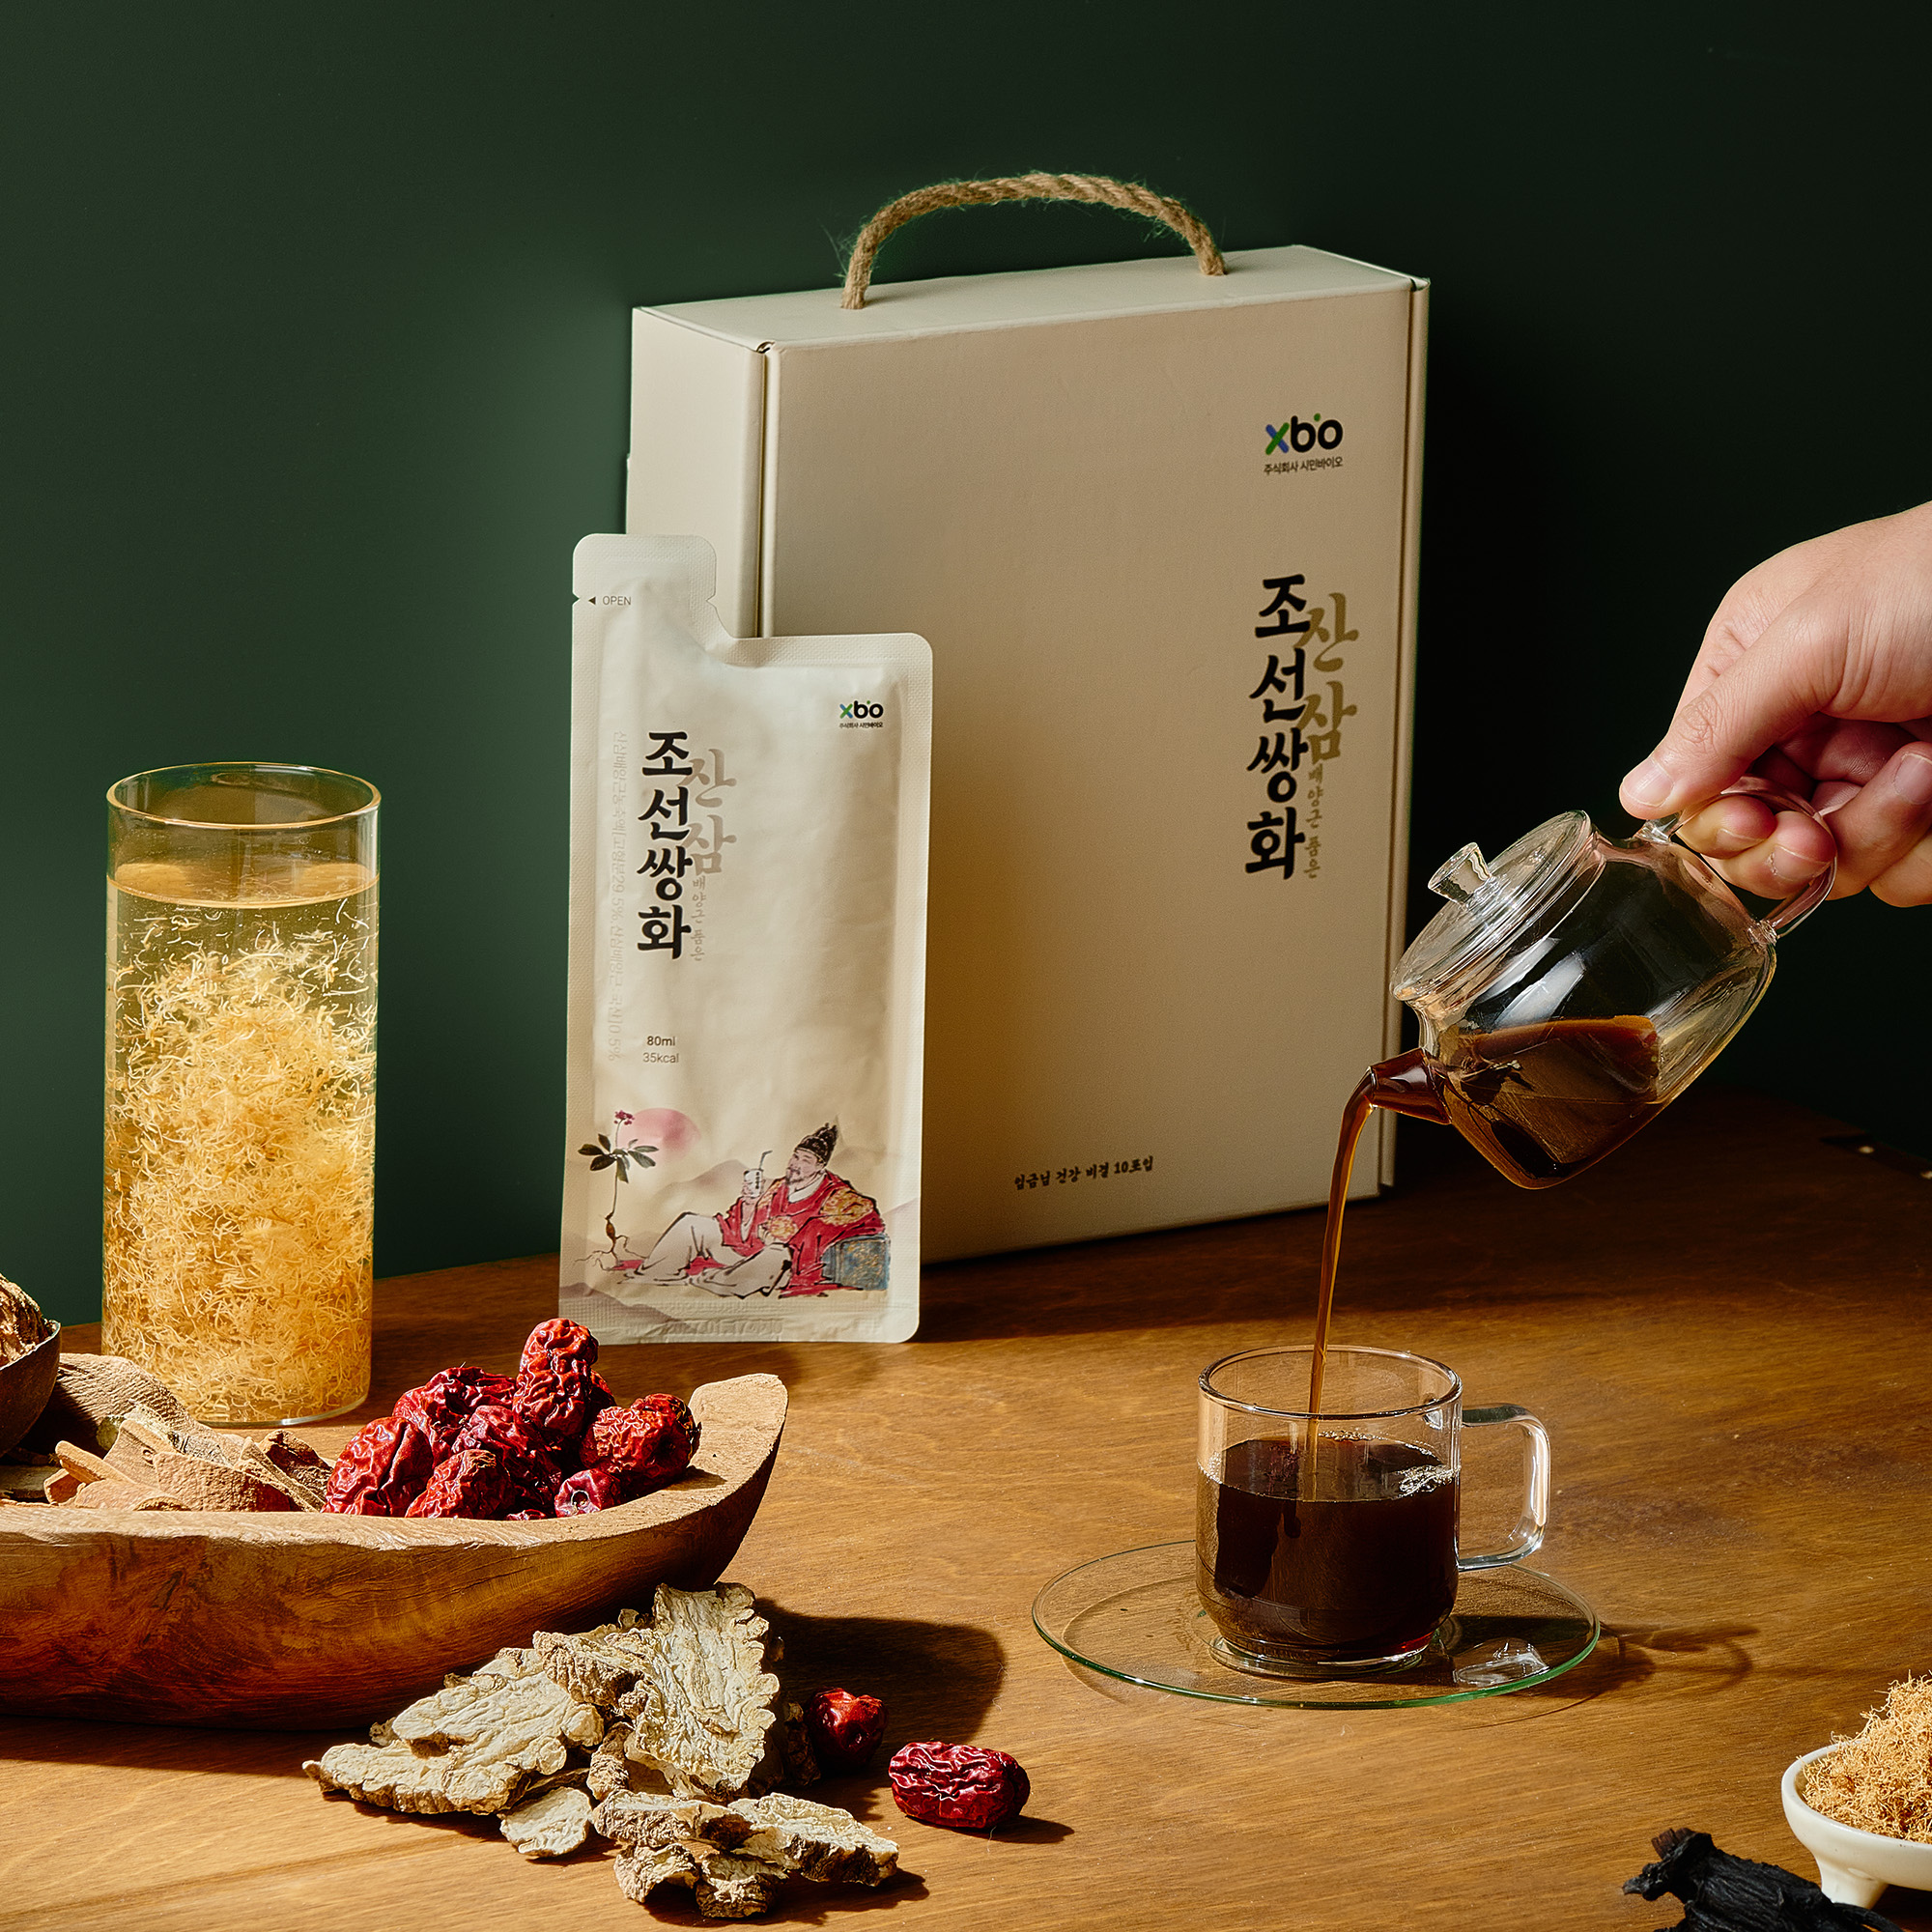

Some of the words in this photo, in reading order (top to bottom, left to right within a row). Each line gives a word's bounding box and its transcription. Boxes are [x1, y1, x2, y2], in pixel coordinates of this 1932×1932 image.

[1264, 461, 1298, 475] 주식회사
[602, 595, 632, 606] OPEN
[1245, 574, 1311, 880] 조선쌍화
[637, 731, 693, 959] 조선쌍화
[647, 1036, 676, 1046] 80ml
[642, 1052, 679, 1064] 35kcal
[1014, 1170, 1050, 1190] 임금님
[1056, 1166, 1081, 1184] 건강
[1086, 1162, 1110, 1179] 비결
[1114, 1155, 1154, 1175] 10포입
